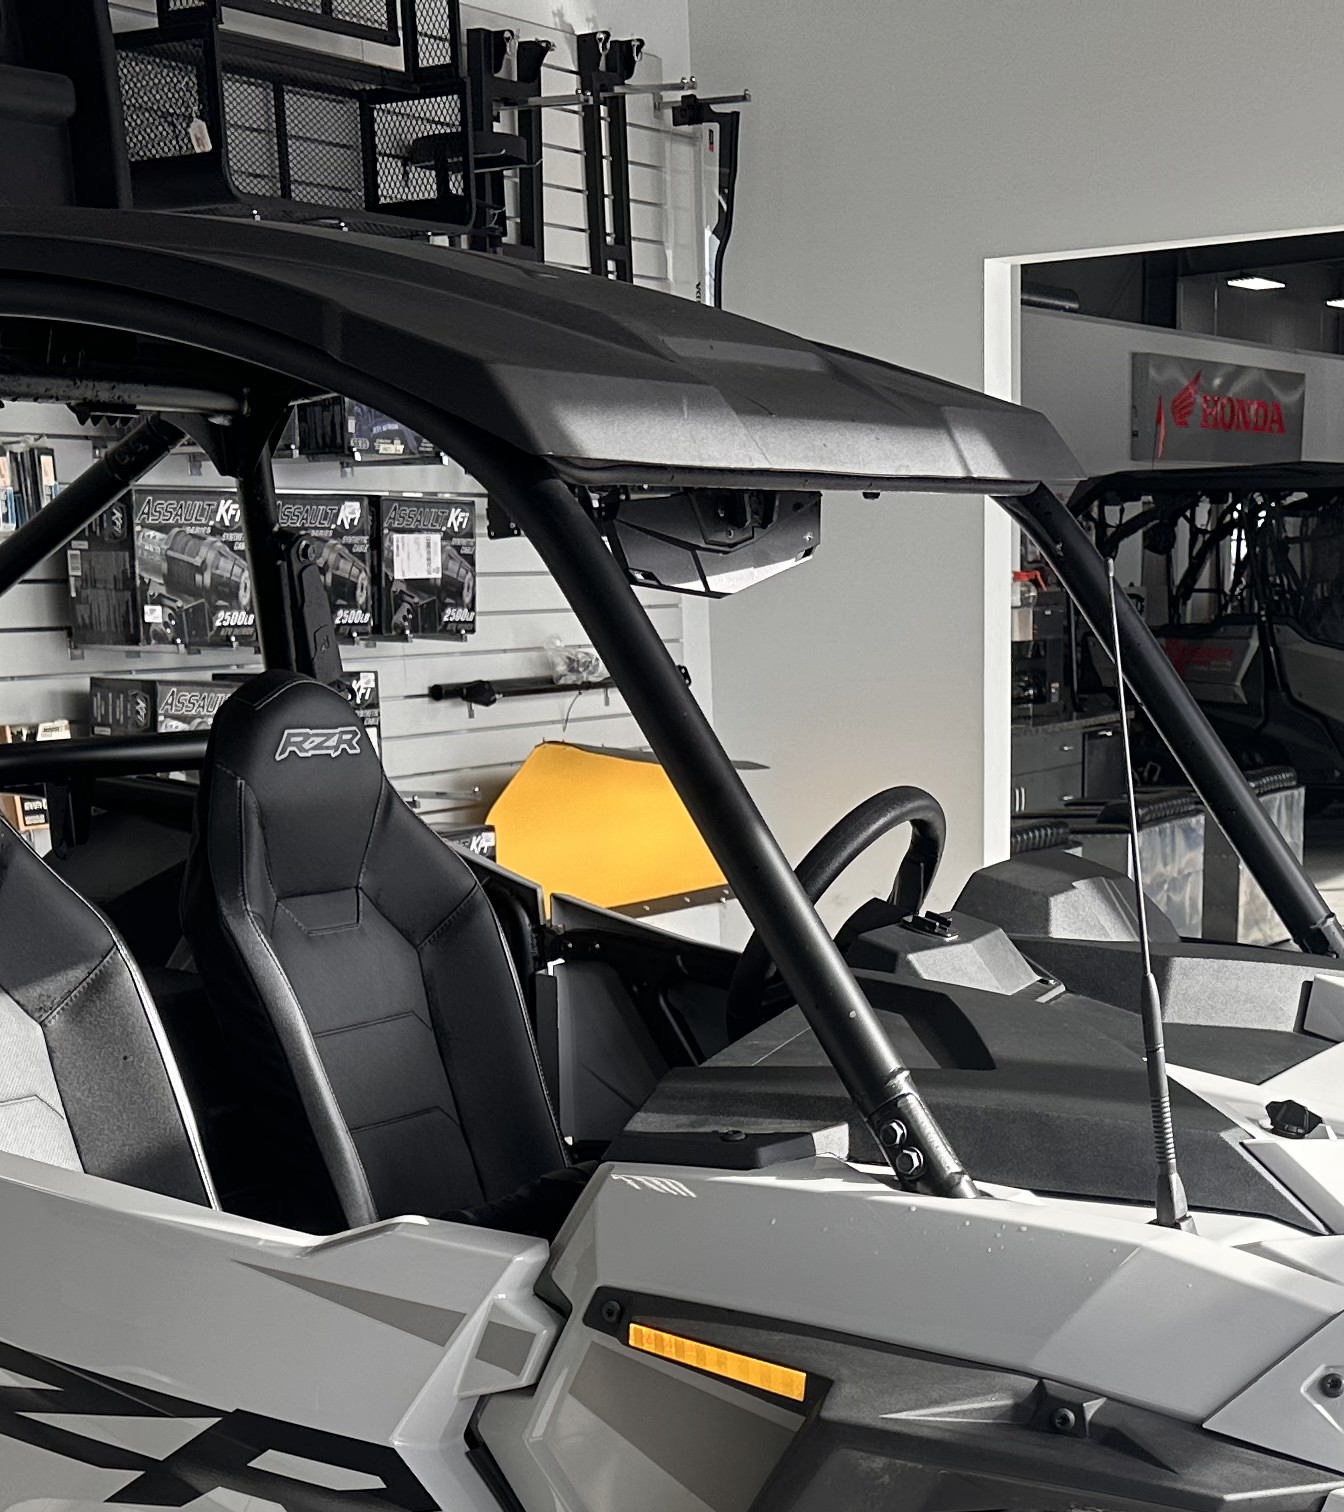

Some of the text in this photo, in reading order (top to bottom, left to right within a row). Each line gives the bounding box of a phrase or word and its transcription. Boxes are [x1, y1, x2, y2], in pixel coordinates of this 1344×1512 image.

[1200, 393, 1286, 435] HONDA
[135, 496, 217, 524] ASSAULT
[383, 503, 449, 529] ASSAULT
[215, 610, 255, 626] 2500LB
[335, 609, 371, 625] 2500LB
[275, 727, 361, 761] RZR
